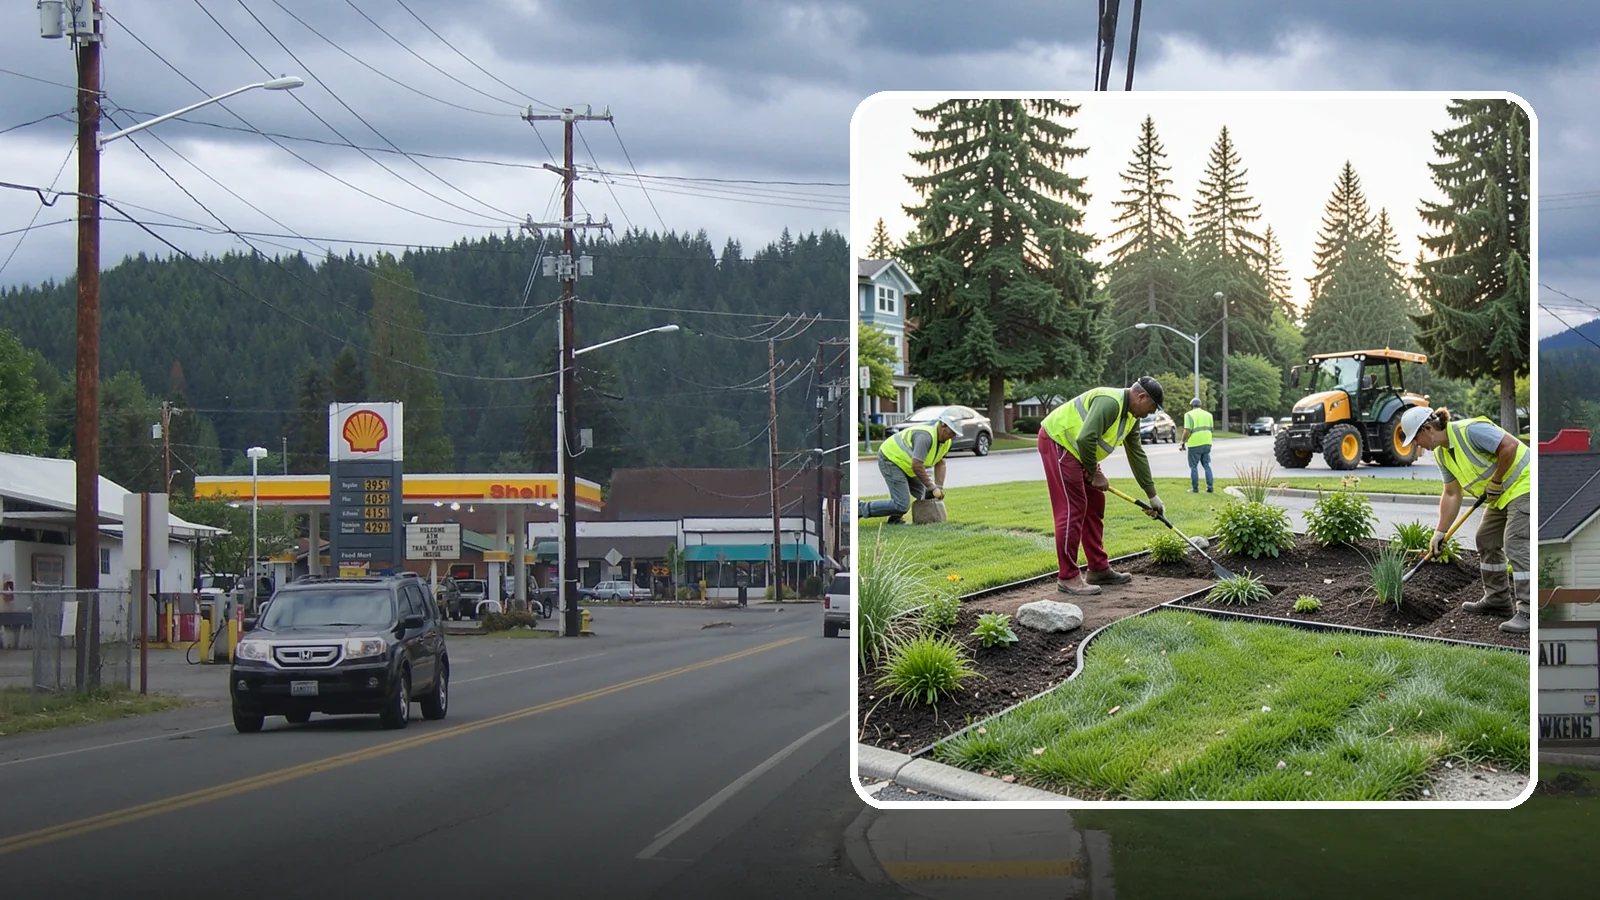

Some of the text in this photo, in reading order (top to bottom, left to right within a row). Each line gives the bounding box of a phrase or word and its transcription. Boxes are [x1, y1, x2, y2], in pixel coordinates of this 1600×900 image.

[366, 480, 384, 490] 395
[490, 484, 547, 499] Shell
[366, 494, 384, 504] 405
[366, 508, 384, 518] 415
[366, 522, 384, 532] 429
[1538, 643, 1567, 665] AID
